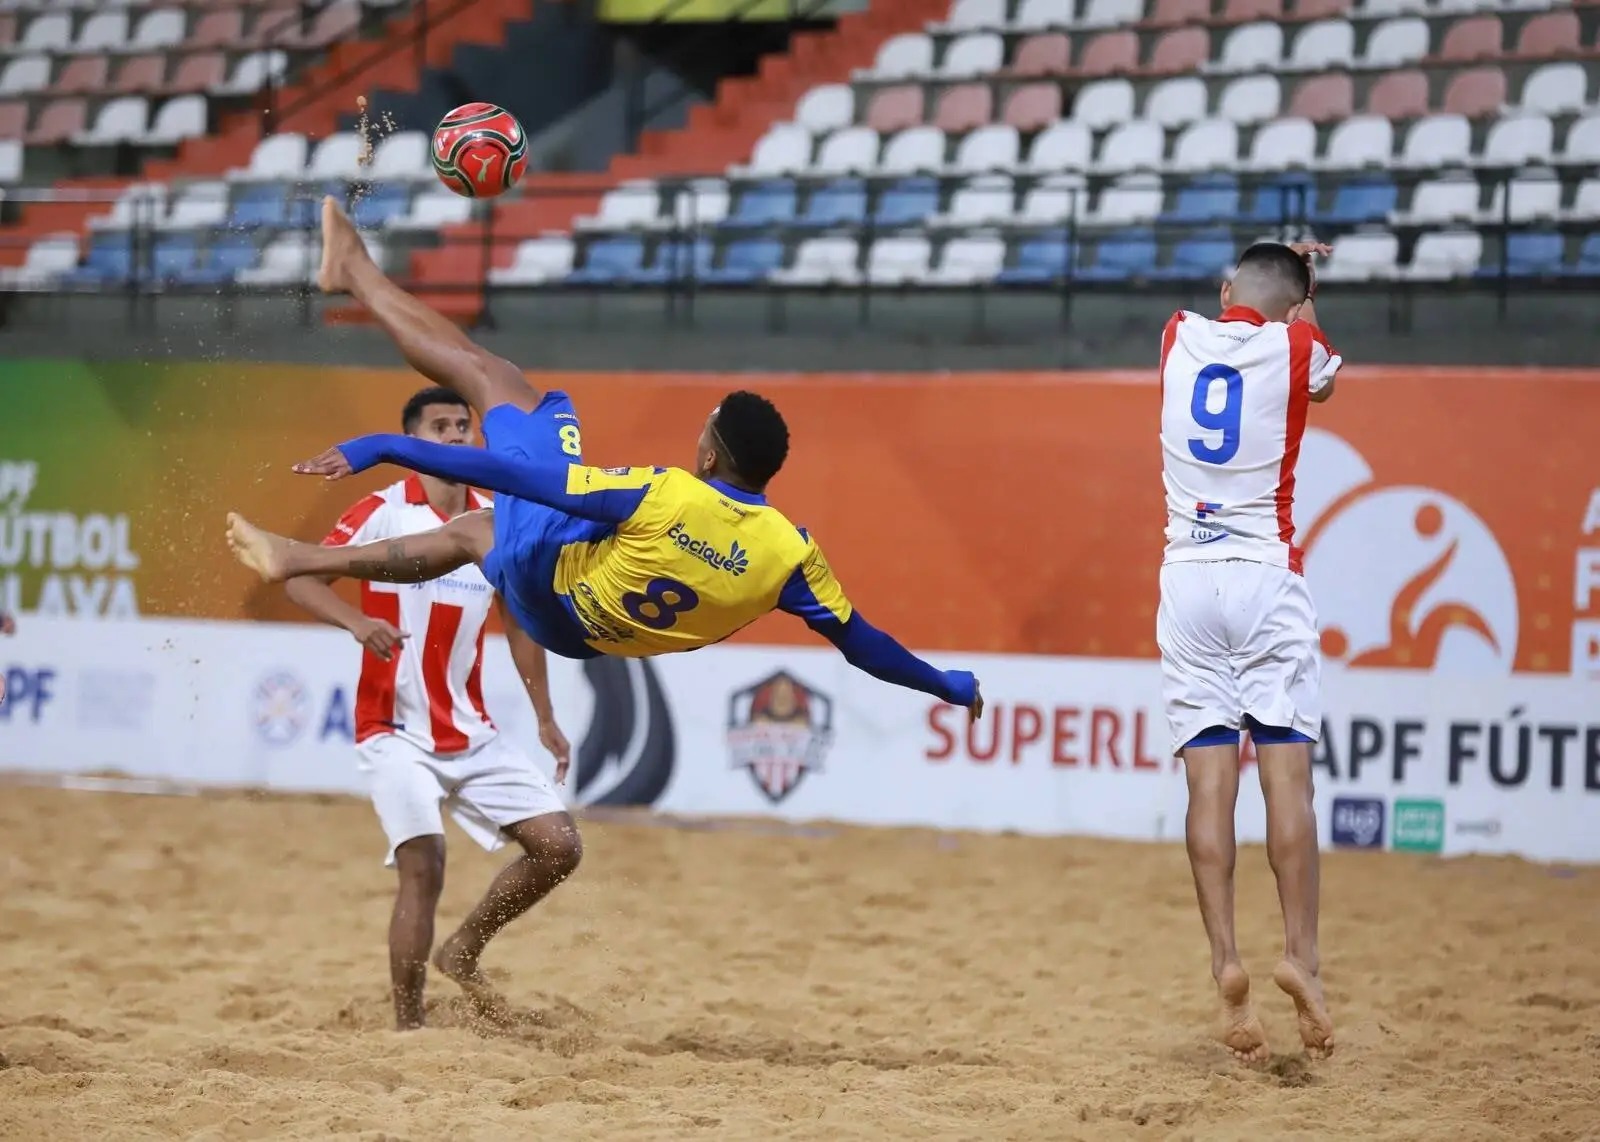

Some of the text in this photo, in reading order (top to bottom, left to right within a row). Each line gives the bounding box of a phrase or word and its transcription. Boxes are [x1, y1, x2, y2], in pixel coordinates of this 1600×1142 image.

[558, 424, 582, 457] 8
[1188, 363, 1243, 465] 9
[621, 576, 700, 630] 8
[0, 666, 54, 723] PF
[925, 702, 1180, 771] SUPERL
